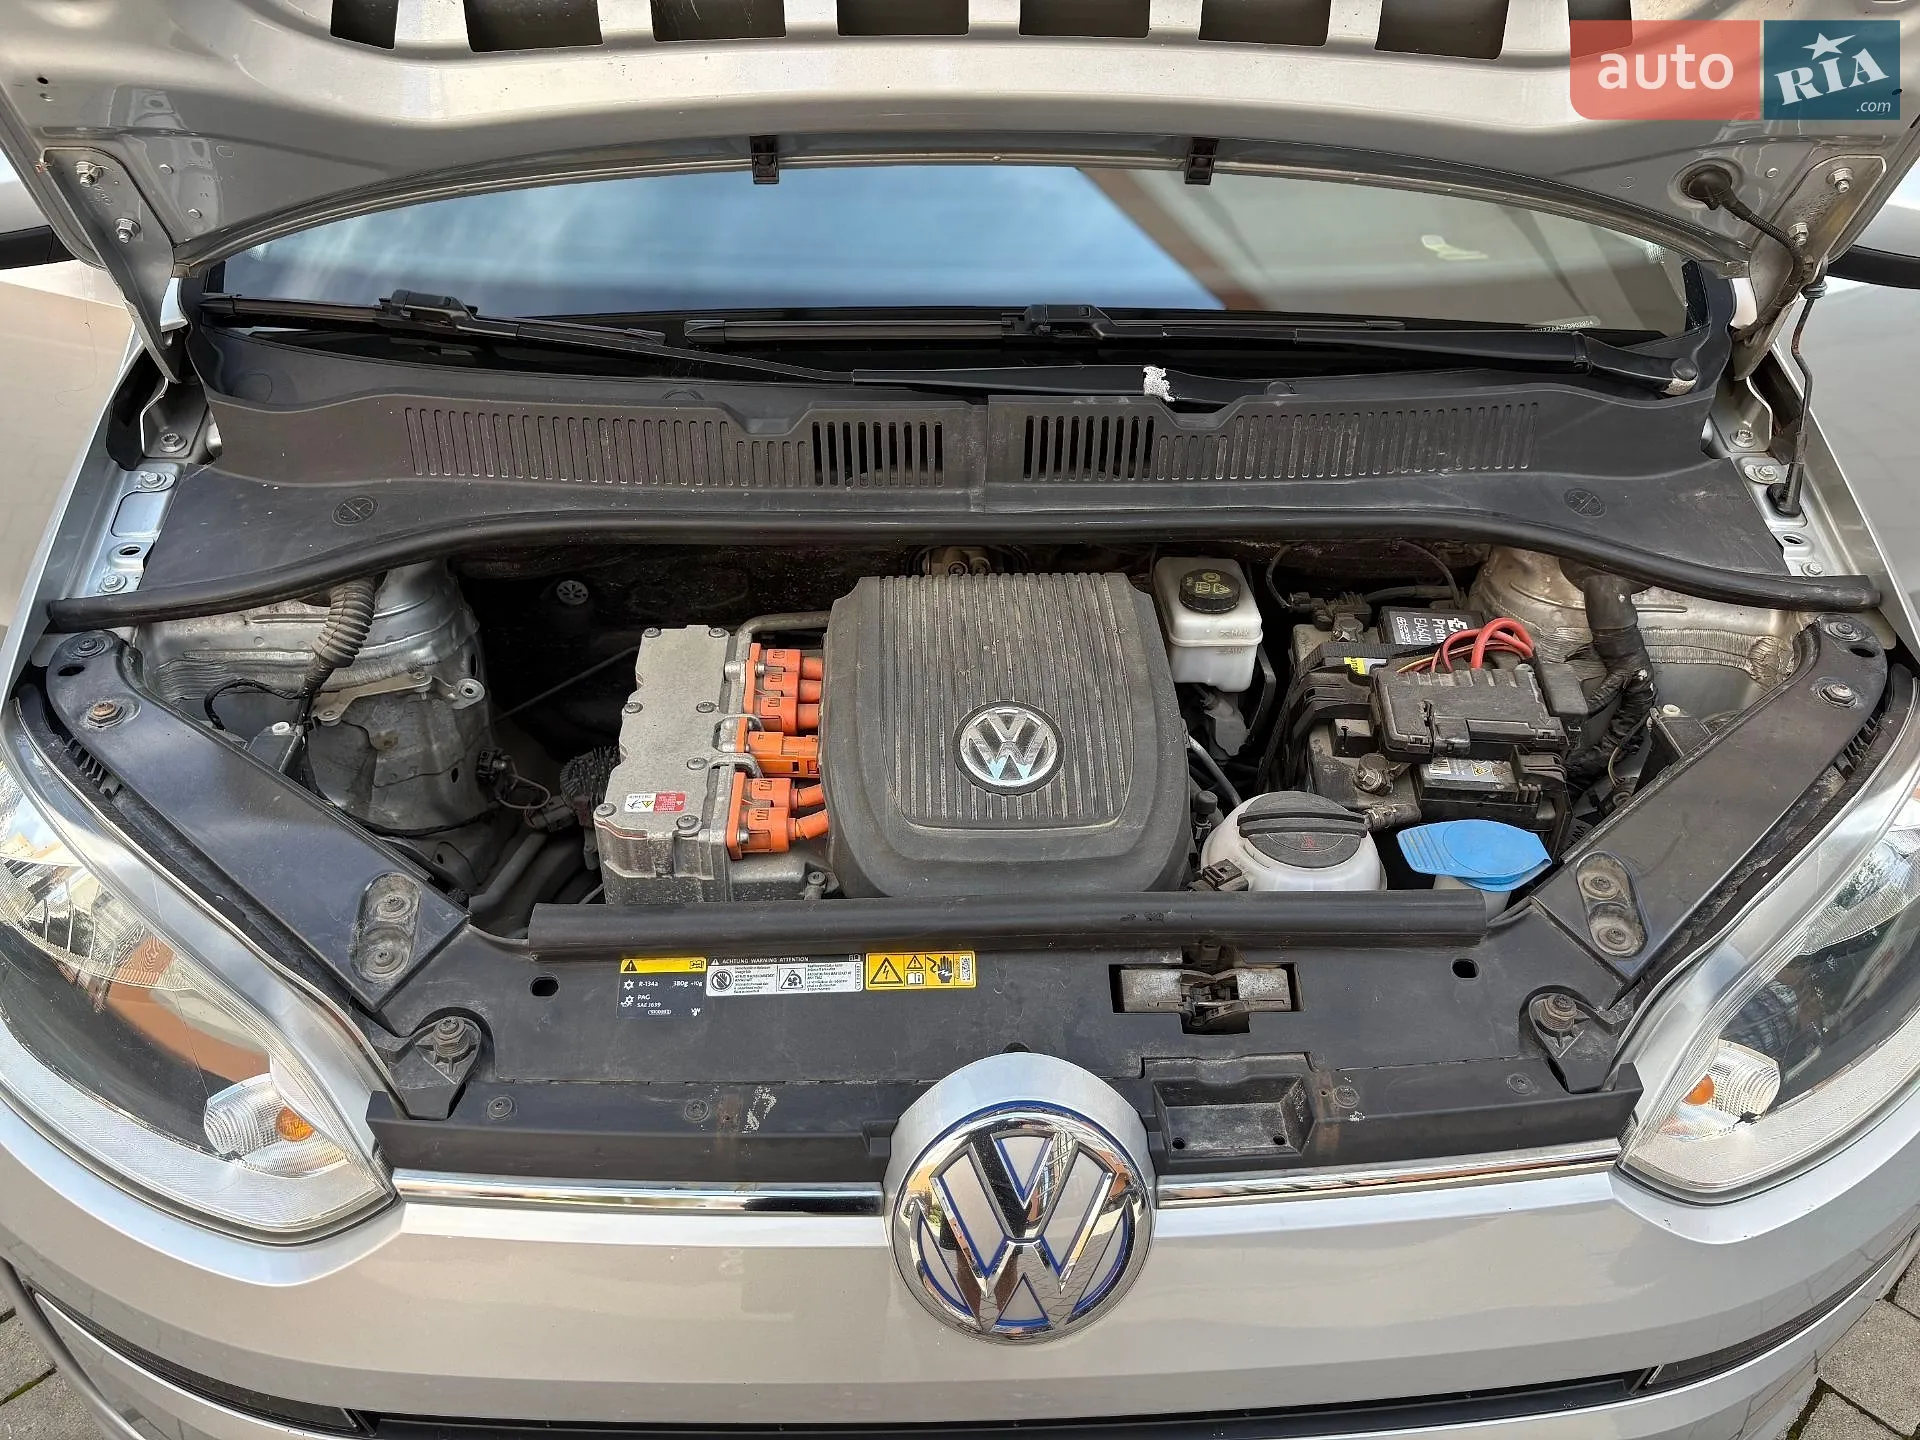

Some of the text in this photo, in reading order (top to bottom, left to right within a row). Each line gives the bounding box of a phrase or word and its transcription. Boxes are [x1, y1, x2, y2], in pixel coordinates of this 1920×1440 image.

[1413, 617, 1432, 642] EA640
[1431, 618, 1447, 643] Prem
[722, 955, 810, 965] ACHTUNG WARNING ATTENTION
[892, 1102, 1153, 1345] VW
